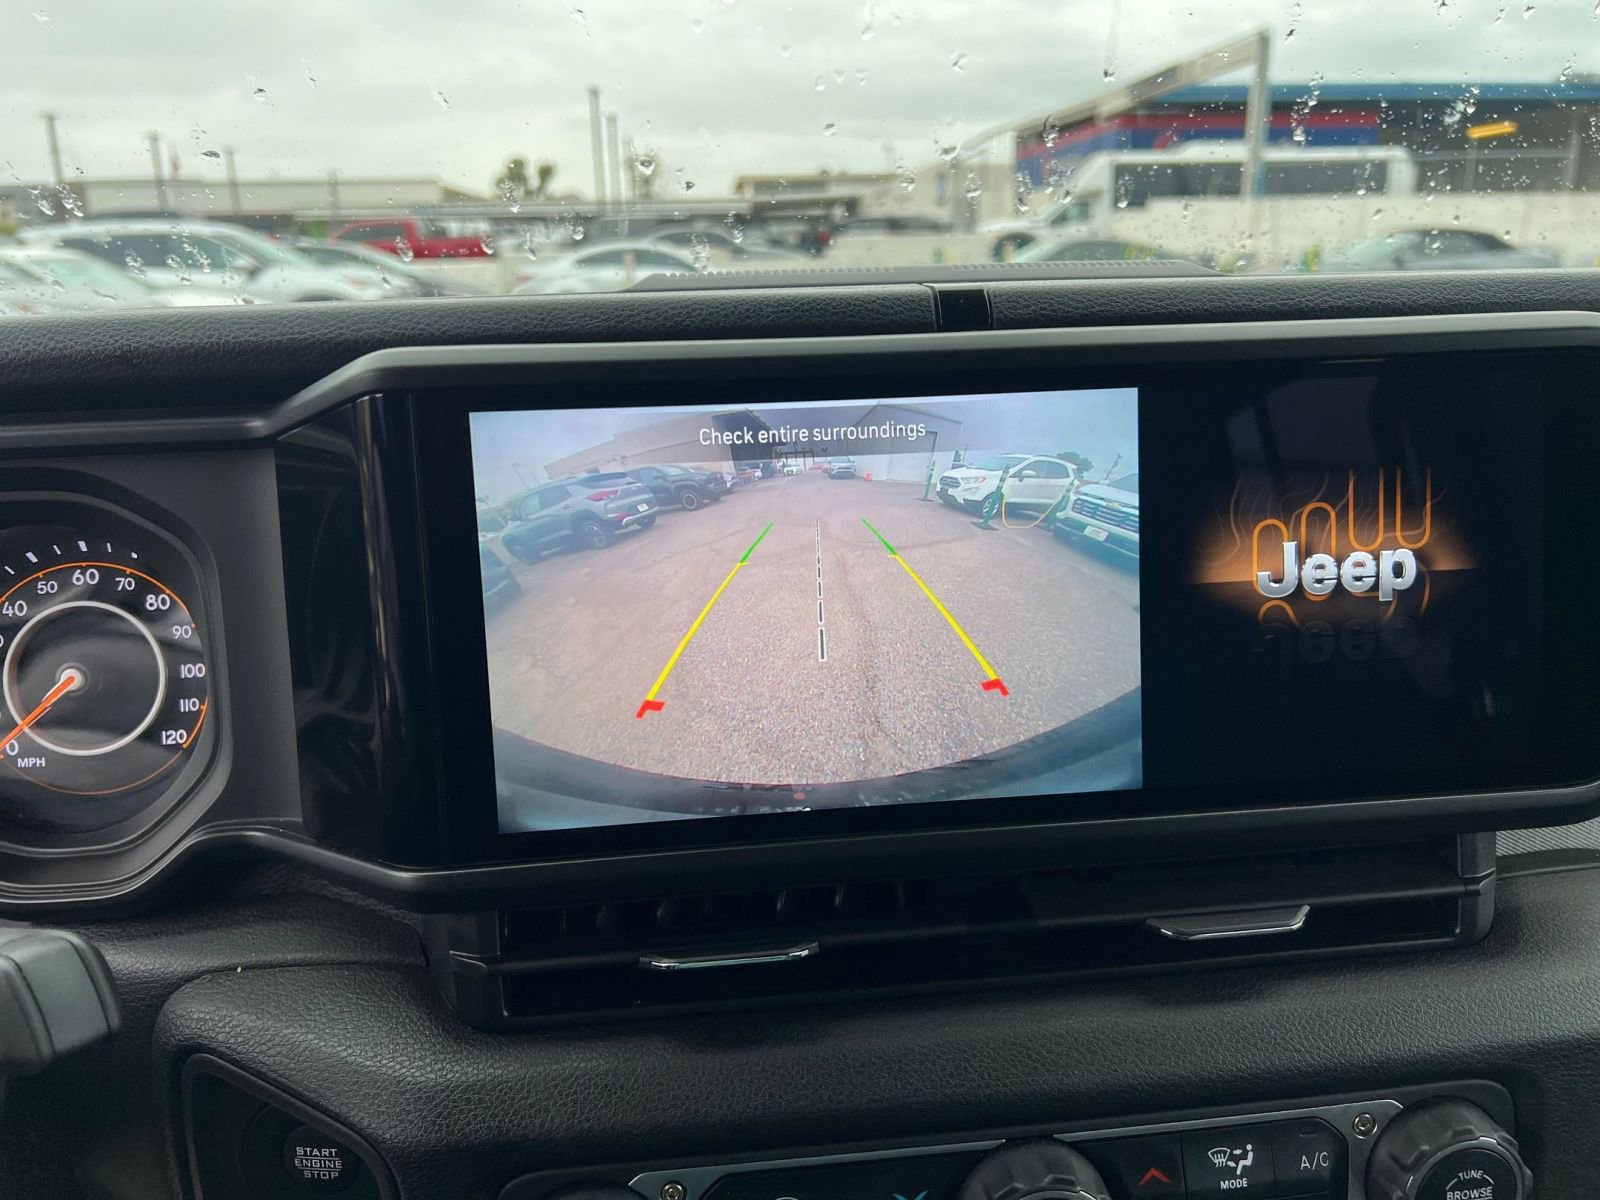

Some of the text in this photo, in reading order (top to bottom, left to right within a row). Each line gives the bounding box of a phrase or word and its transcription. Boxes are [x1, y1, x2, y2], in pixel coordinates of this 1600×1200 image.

[699, 421, 926, 446] Check entire surroundings
[72, 569, 99, 585] 60
[1256, 541, 1417, 601] Jeep
[37, 581, 58, 594] 50
[115, 577, 135, 591] 70
[2, 601, 28, 616] 40
[145, 594, 171, 610] 80
[172, 625, 192, 639] 90
[180, 662, 206, 678] 100
[179, 697, 199, 712] 110
[162, 730, 187, 746] 120
[6, 740, 19, 756] 0
[17, 757, 46, 768] MPH
[296, 1146, 338, 1157] START
[294, 1158, 343, 1169] ENGINE
[1300, 1152, 1329, 1170] A/C
[303, 1170, 339, 1179] STOP
[1457, 1169, 1484, 1180] TUNE
[1220, 1178, 1248, 1190] MODE
[1446, 1186, 1493, 1200] BROWSE
